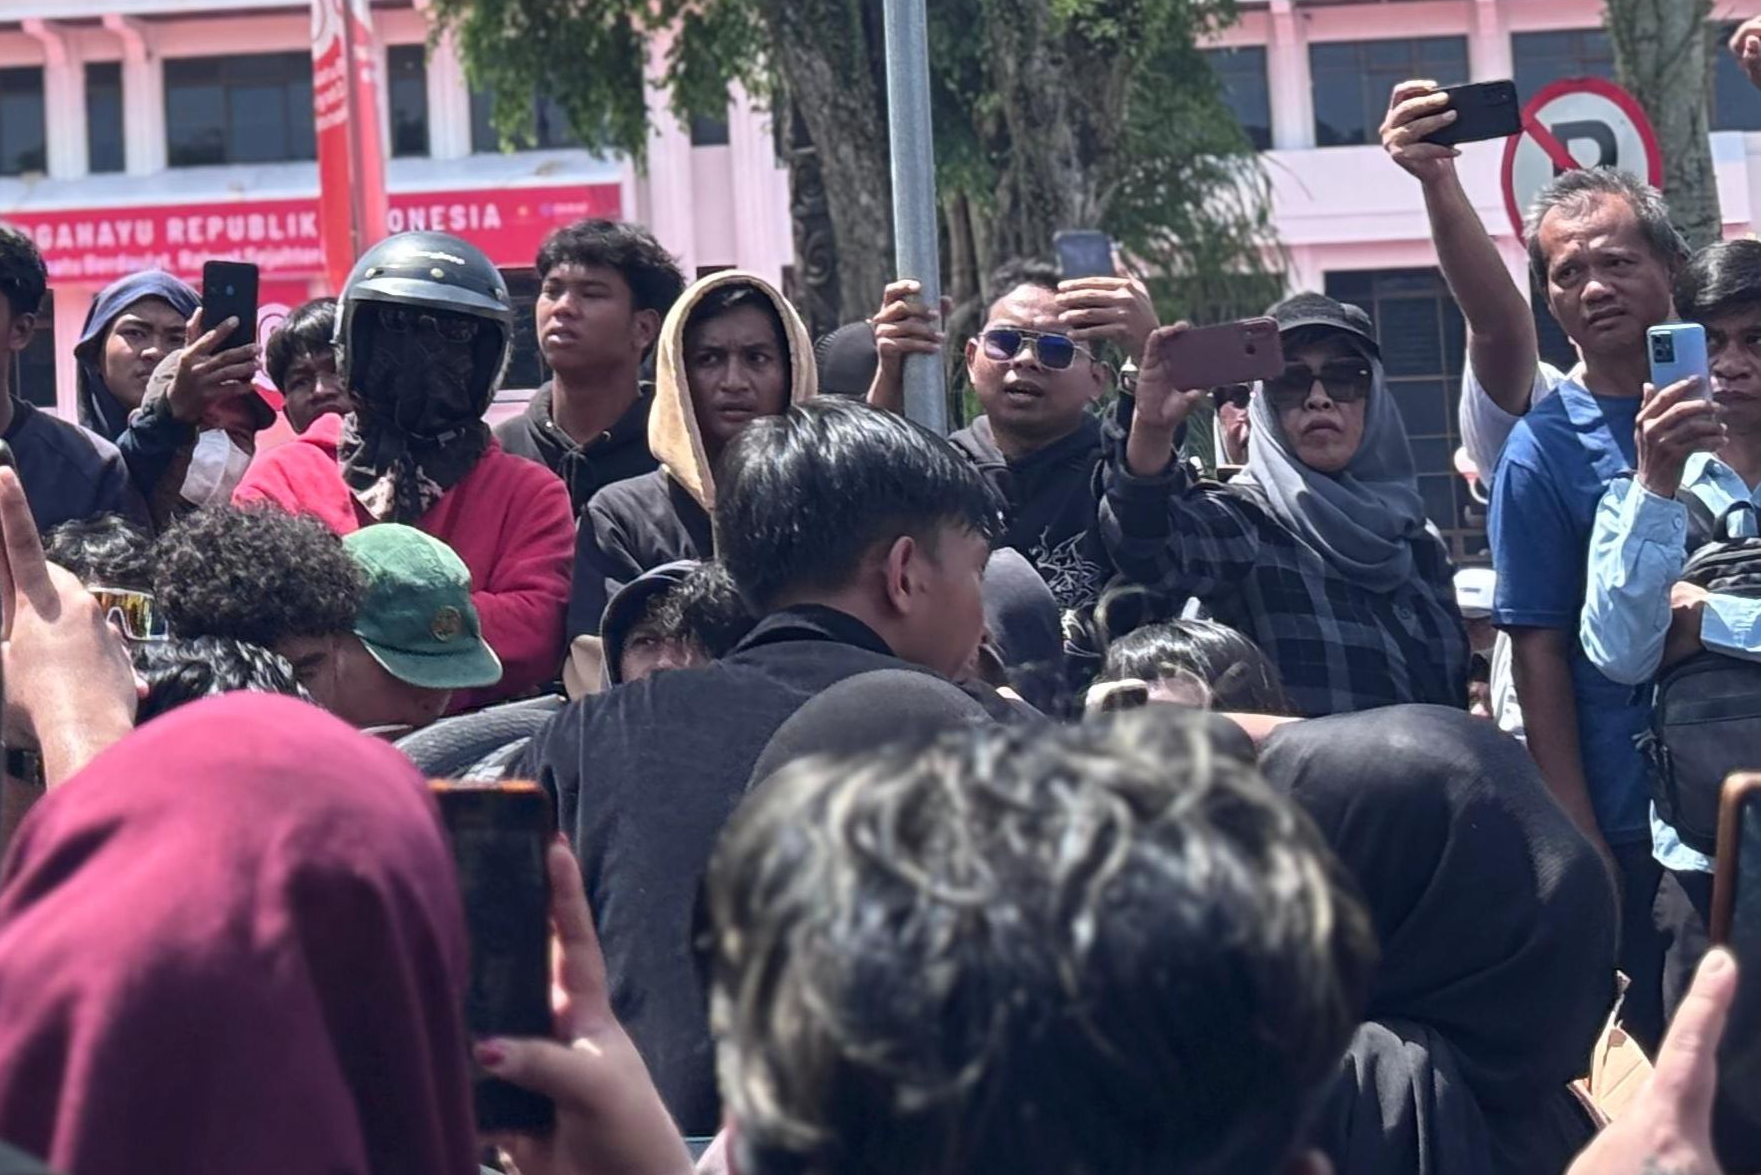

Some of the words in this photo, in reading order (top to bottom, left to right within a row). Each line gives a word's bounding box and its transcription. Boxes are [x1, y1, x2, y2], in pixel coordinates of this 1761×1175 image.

[17, 219, 155, 251] GAHAYU
[166, 211, 318, 245] REPUBLIK
[389, 203, 502, 233] ONESIA
